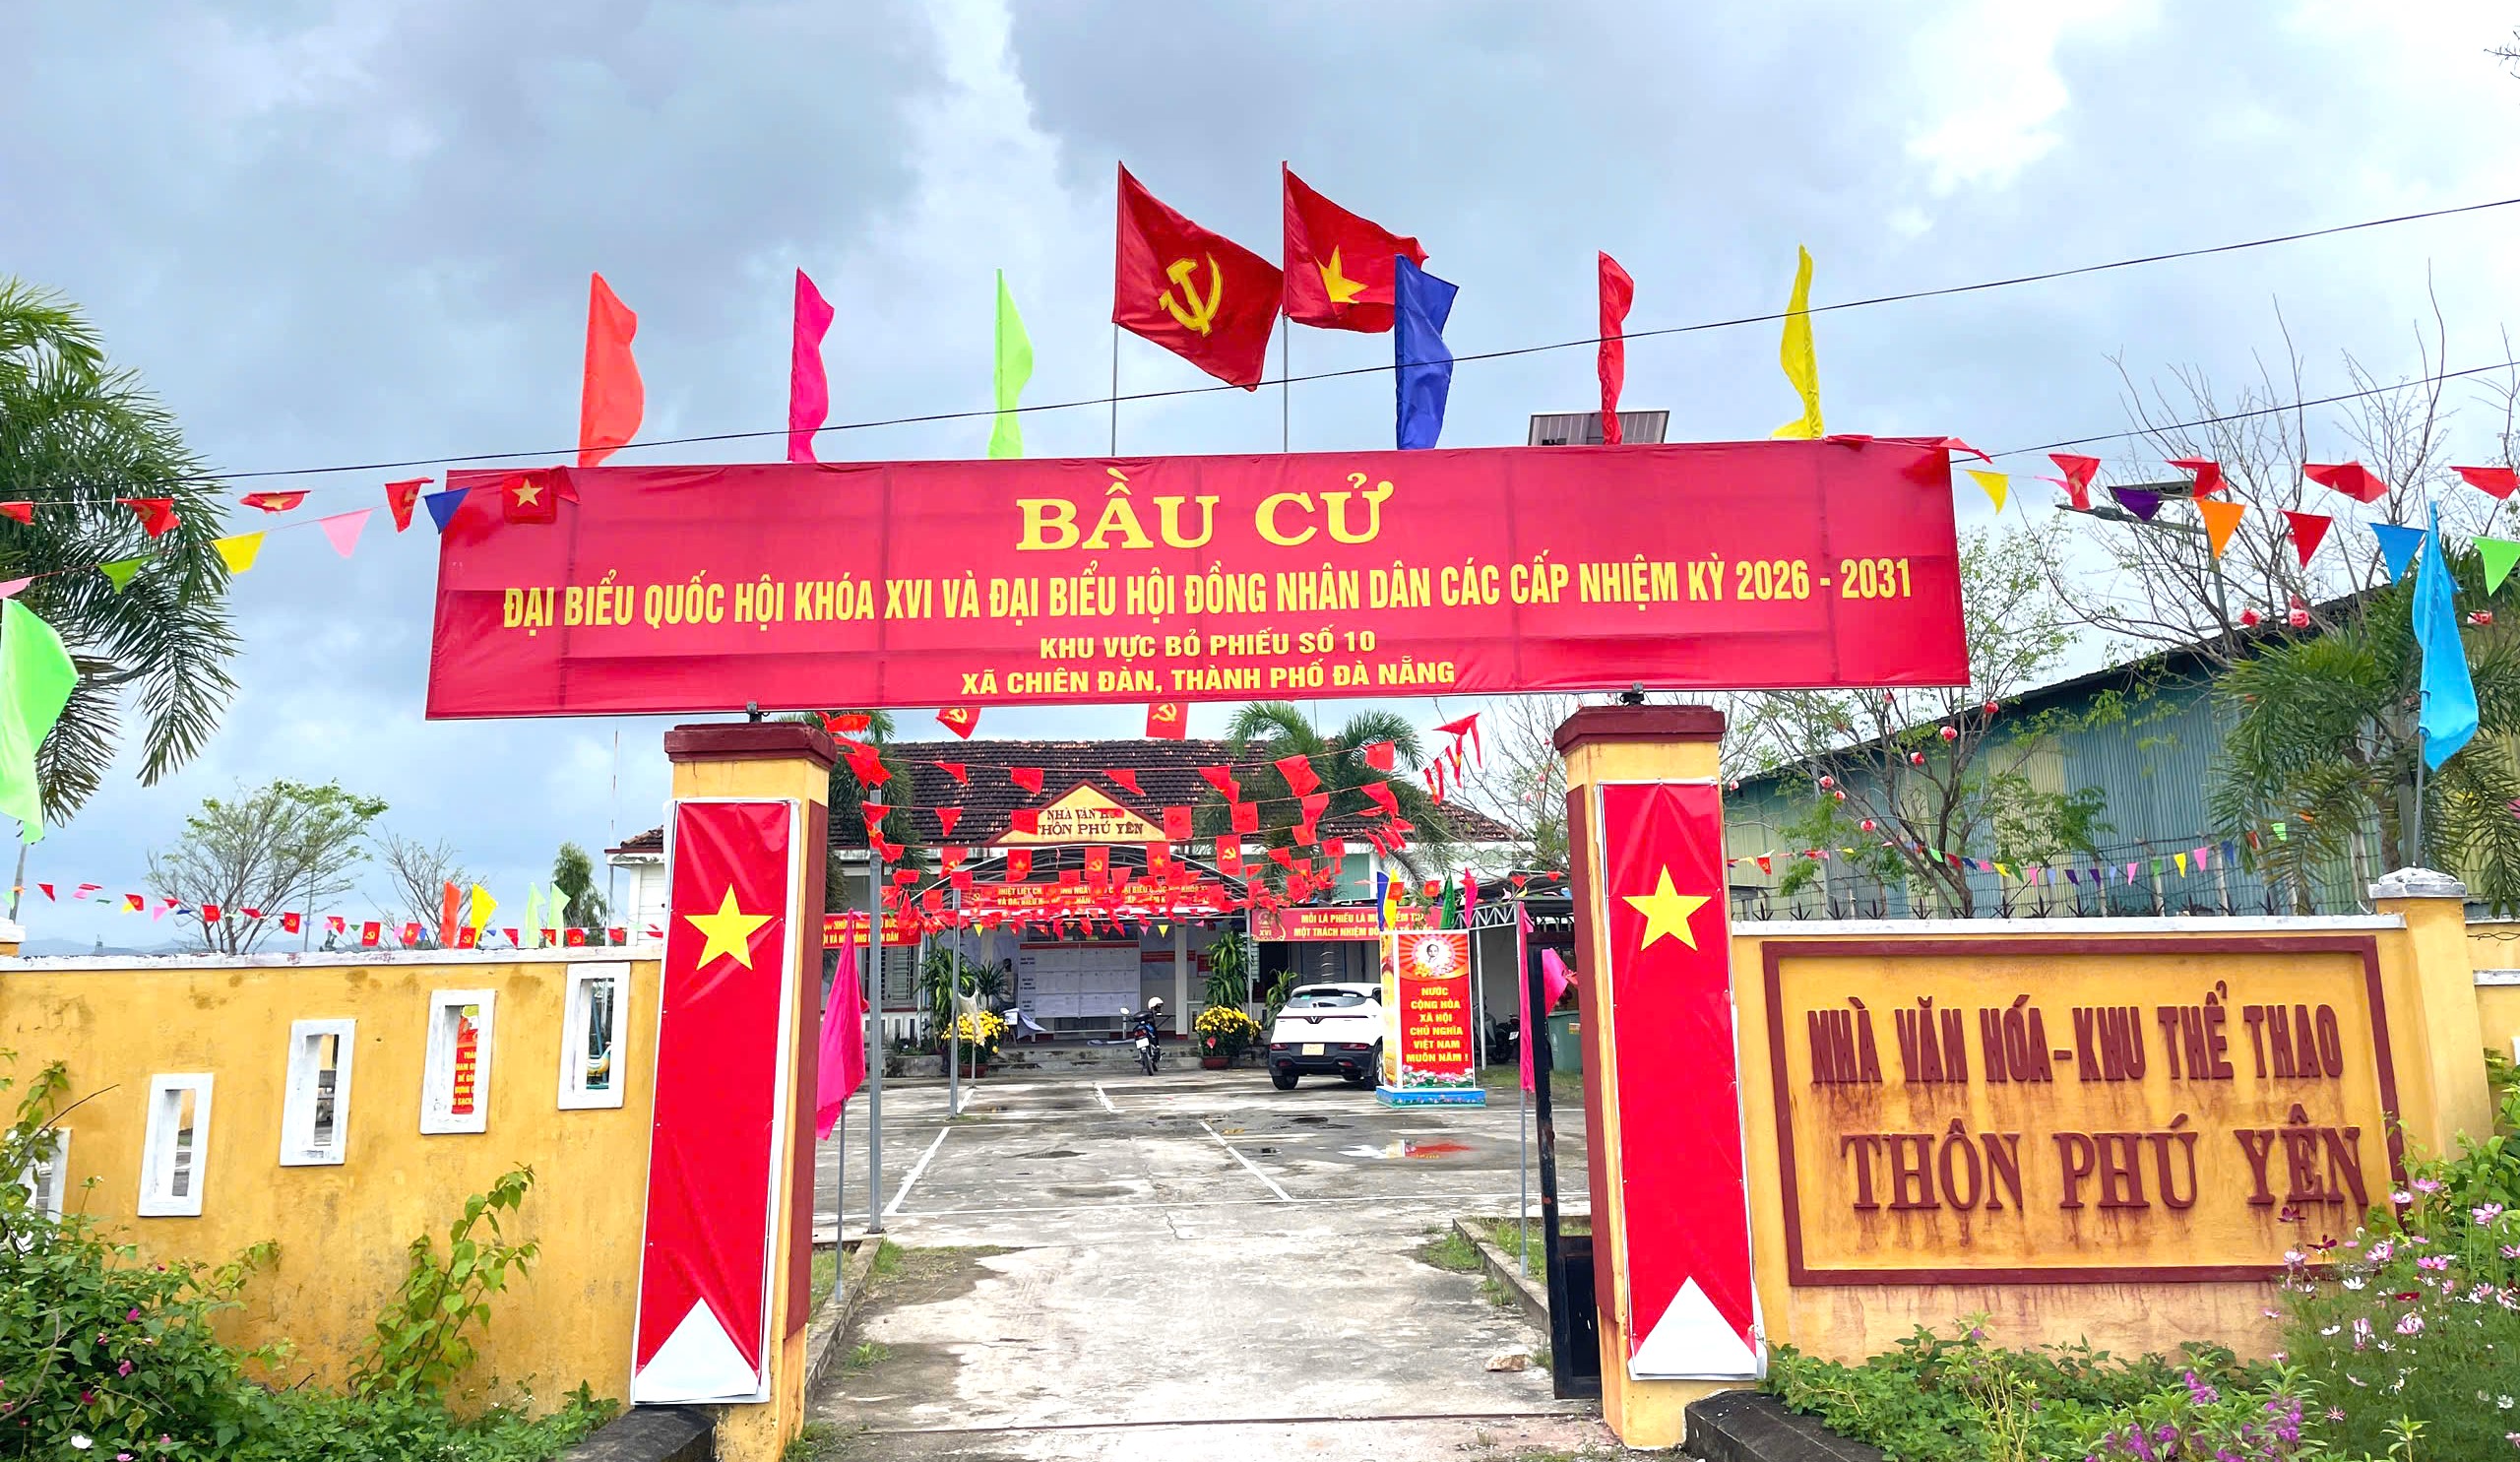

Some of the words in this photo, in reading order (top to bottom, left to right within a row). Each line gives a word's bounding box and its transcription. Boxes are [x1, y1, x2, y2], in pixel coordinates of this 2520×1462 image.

[1016, 468, 1219, 551] BẦU
[1255, 473, 1395, 546] CỬ
[504, 587, 554, 636] ĐẠI
[565, 570, 634, 625] BIỂU
[645, 569, 724, 628] QUỐC
[735, 574, 784, 630] HỘI
[795, 572, 874, 621] KHÓA
[885, 579, 932, 618] XVI
[942, 570, 979, 618] VÀ
[989, 578, 1039, 626] ĐẠI
[1049, 561, 1115, 616] BIỂU
[1127, 567, 1174, 622] HỘI
[1185, 560, 1266, 613] ĐỒNG
[1277, 563, 1359, 611] NHÂN
[1370, 561, 1430, 608] DÂN
[1441, 556, 1499, 606] CÁC
[1510, 549, 1569, 604] CẤP
[1580, 554, 1677, 610] NHIỆM
[1688, 552, 1725, 602] KỲ
[1736, 560, 1810, 601] 2026
[1842, 559, 1911, 599] 2031
[1040, 638, 1094, 659] KHU
[1103, 635, 1156, 662] VỰC
[1166, 630, 1201, 657] BỎ
[1211, 630, 1289, 656] PHIẾU
[1299, 627, 1335, 654] SỐ
[1346, 630, 1375, 652] 10
[962, 670, 998, 695] XÃ
[1008, 667, 1090, 693] CHIÊN
[1098, 667, 1162, 695] ĐÀN,
[1172, 665, 1260, 691] THÀNH
[1270, 661, 1324, 689] PHỐ
[1333, 662, 1369, 687] ĐÀ
[1378, 659, 1454, 685] NẴNG
[1047, 807, 1072, 820] NHÀ
[1075, 807, 1096, 820] VĂN
[1039, 821, 1072, 835] HÔN
[1078, 821, 1110, 835] PHÚ
[1115, 821, 1144, 835] YÊN
[1330, 912, 1354, 923] PHIẾU
[1293, 925, 1310, 938] MỘT
[1312, 925, 1339, 936] TRÁCH
[1340, 925, 1366, 937] NHIỆM
[1368, 925, 1380, 936] ĐỐ
[1421, 986, 1449, 996] NƯỚC
[1411, 1000, 1437, 1011] CỘNG
[1419, 1012, 1433, 1023] XÃ
[1435, 1012, 1452, 1024] HỘI
[1410, 1025, 1429, 1036] CHỦ
[1432, 1025, 1463, 1036] NGHĨA
[1807, 996, 1882, 1082] NHÀ
[1895, 996, 1968, 1082] VĂN
[2157, 980, 2234, 1080] THỂ
[2243, 1003, 2344, 1079] THAO
[1414, 1039, 1434, 1050] VIỆT
[1437, 1040, 1460, 1049] NAM
[1406, 1052, 1436, 1062] MUÔN
[1438, 1052, 1462, 1062] NĂM
[1841, 1118, 2024, 1211] THÔN
[2052, 1112, 2199, 1209] PHÚ
[2233, 1103, 2369, 1206] YÊN
